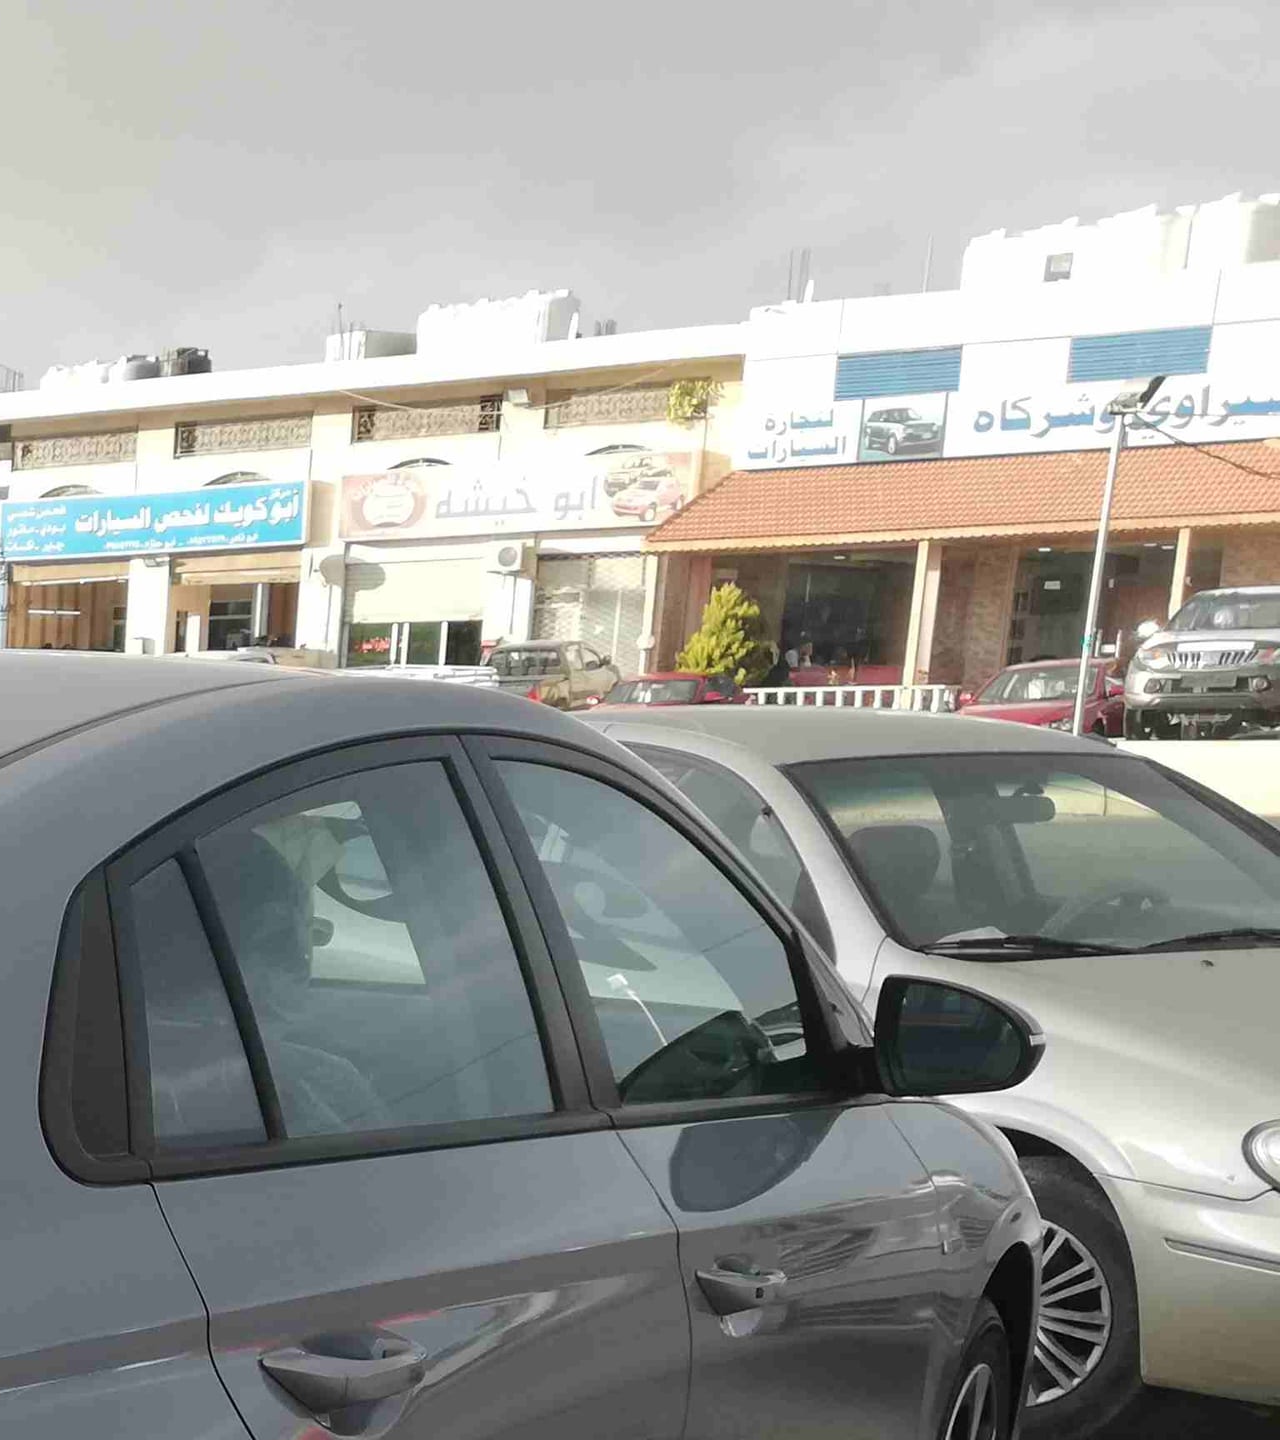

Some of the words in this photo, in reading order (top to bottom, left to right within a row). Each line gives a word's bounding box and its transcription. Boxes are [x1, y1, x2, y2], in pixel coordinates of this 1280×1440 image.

[765, 407, 835, 436] لتجارة
[973, 392, 1117, 438] وشركاه
[747, 435, 848, 464] السيارات
[74, 506, 149, 537] السيارات
